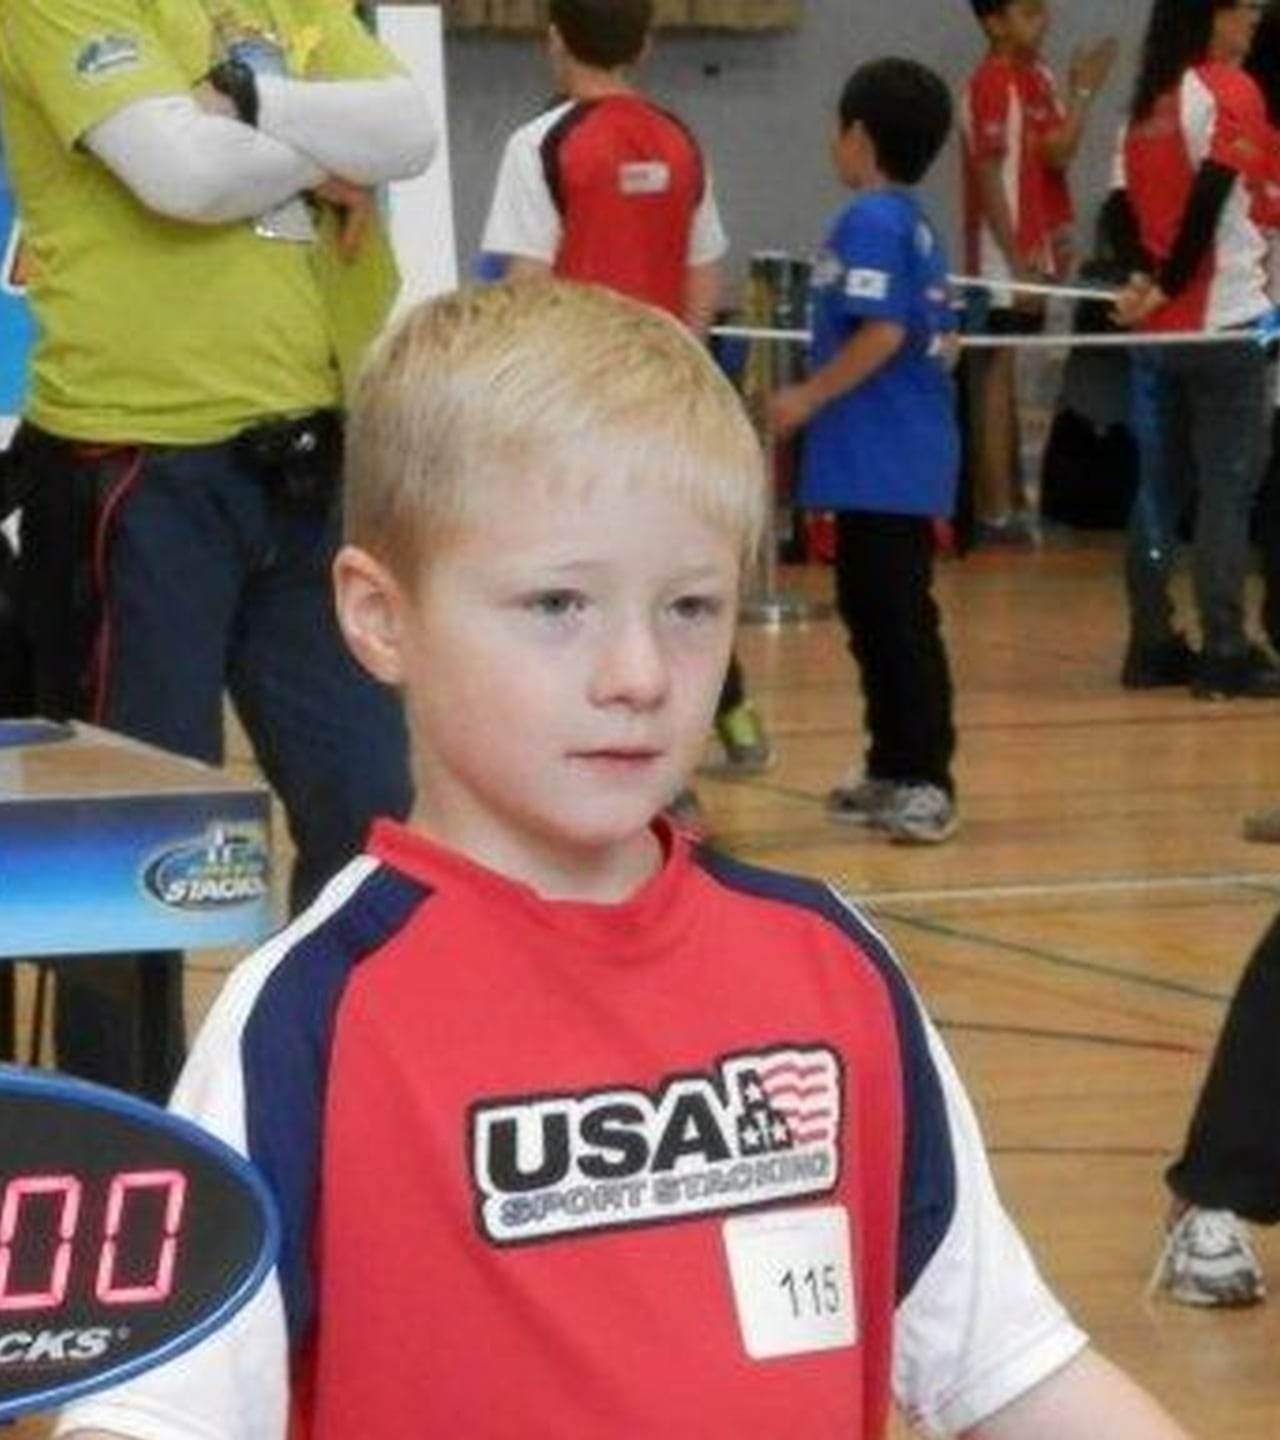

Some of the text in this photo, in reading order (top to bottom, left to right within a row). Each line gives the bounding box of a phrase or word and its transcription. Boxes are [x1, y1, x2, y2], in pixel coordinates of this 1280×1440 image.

[487, 1092, 731, 1194] USA
[499, 1152, 830, 1227] SPORT STACKING
[779, 1265, 841, 1318] 115
